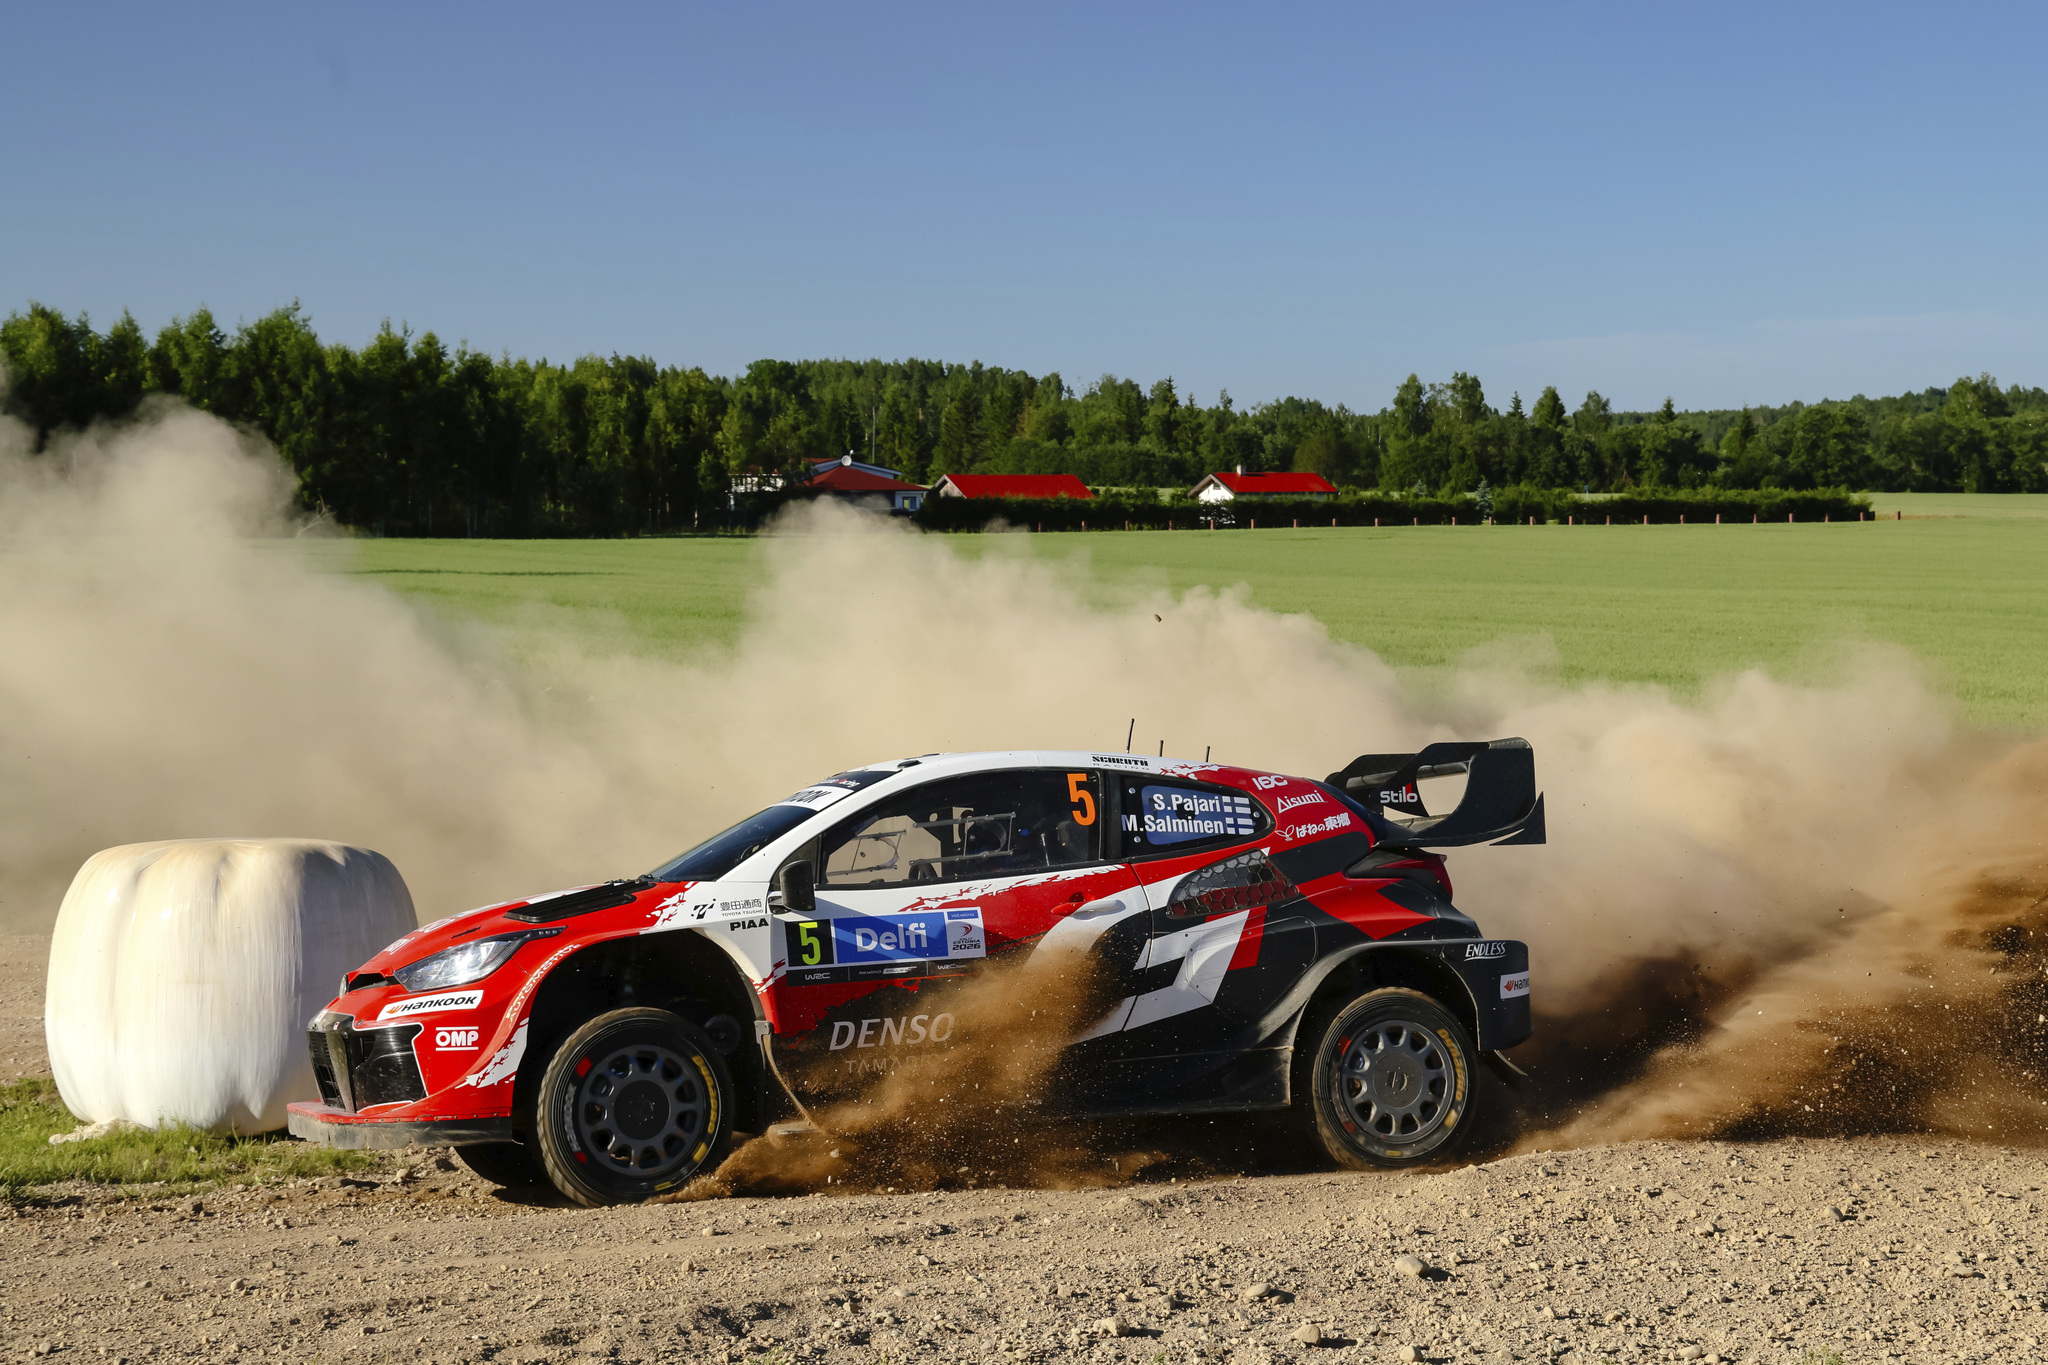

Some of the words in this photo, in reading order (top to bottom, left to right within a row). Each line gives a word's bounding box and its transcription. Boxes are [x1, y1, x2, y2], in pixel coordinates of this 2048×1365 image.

[1092, 756, 1149, 767] SCHROTH
[1067, 773, 1096, 826] 5
[1153, 793, 1221, 815] S.Pajari
[1277, 790, 1325, 814] Aisumi
[1380, 784, 1418, 804] Stilo
[1121, 814, 1225, 834] M.Salminen
[1296, 812, 1351, 839] ばねの東郷
[730, 918, 769, 931] PIAA
[799, 922, 821, 966] 5
[855, 922, 928, 952] Delfi
[1465, 942, 1506, 957] ENDLESS
[805, 972, 831, 981] WRC
[435, 1031, 479, 1047] OMP
[829, 1012, 955, 1051] DENSO
